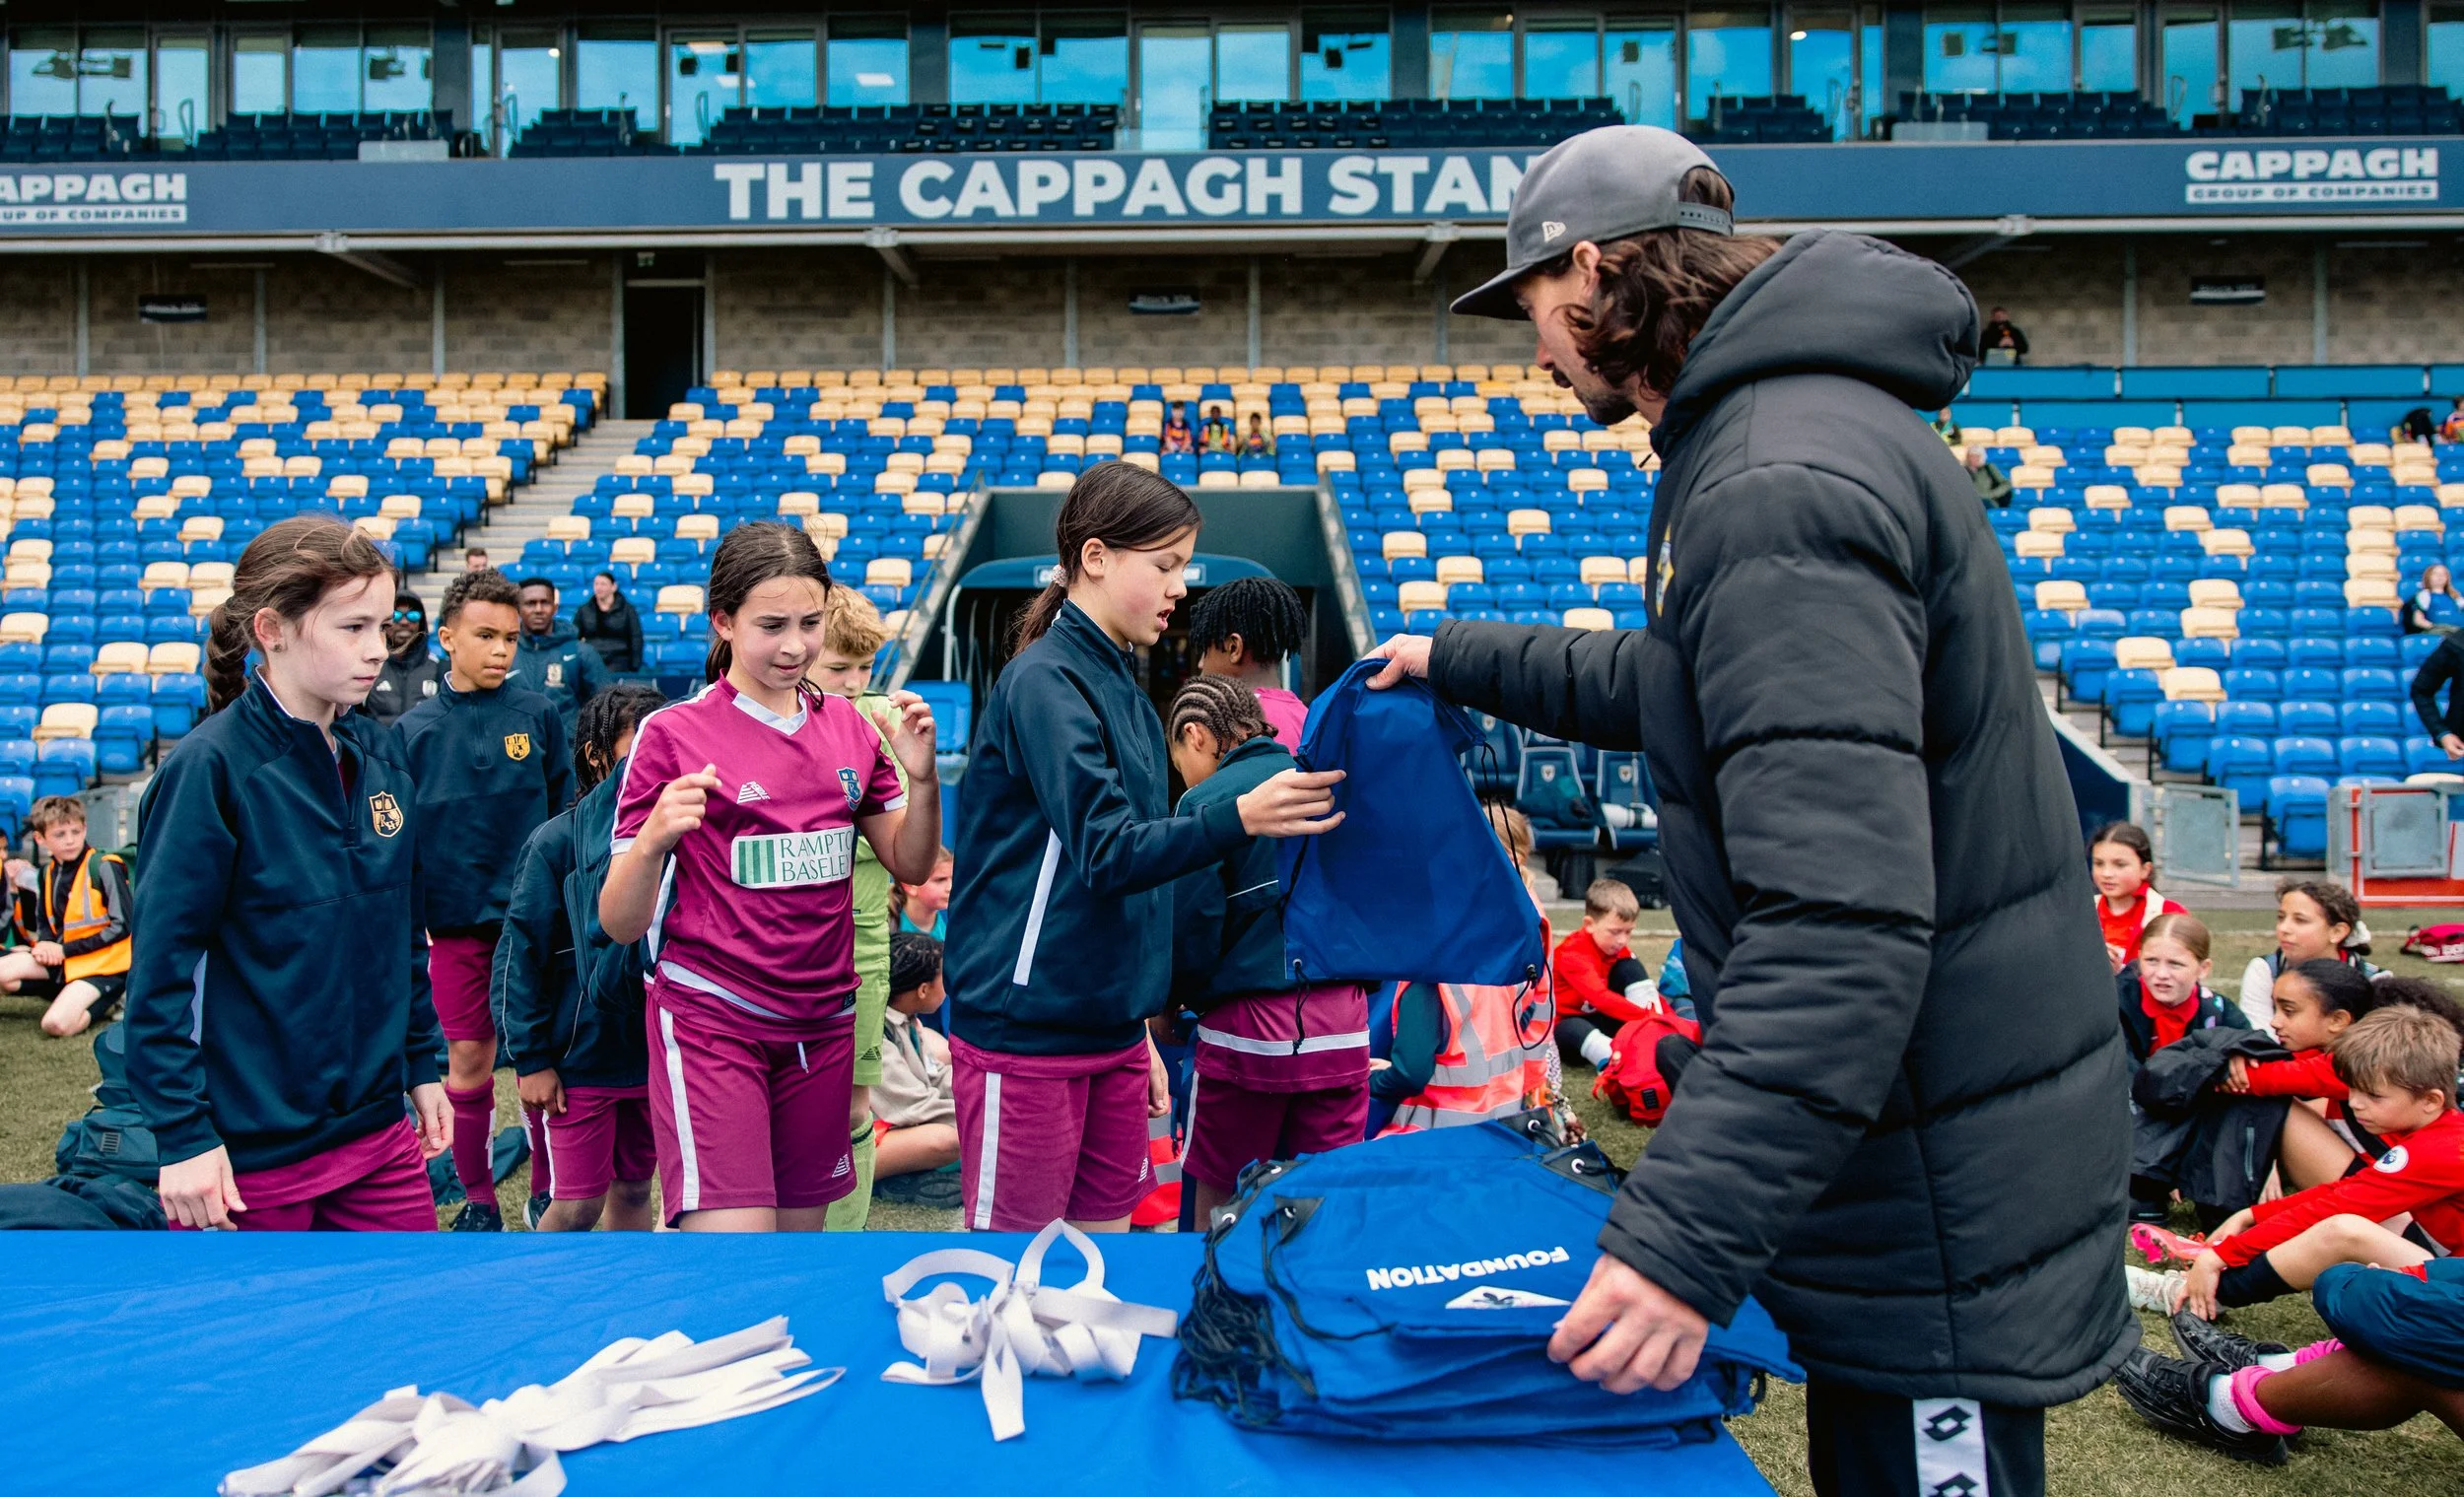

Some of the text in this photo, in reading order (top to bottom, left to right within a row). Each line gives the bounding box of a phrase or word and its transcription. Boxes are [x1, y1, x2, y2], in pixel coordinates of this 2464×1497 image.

[2185, 147, 2439, 181] CAPPAGH
[0, 172, 187, 203] APPAGH
[714, 155, 1543, 220] THE CAPPAGH STAN
[2193, 183, 2431, 200] GROUP OF COMPANIES
[35, 209, 60, 220] OF
[67, 208, 181, 220] COMPANIES
[780, 830, 854, 859] RAMPTO
[1366, 1246, 1570, 1291] FOUNDATION
